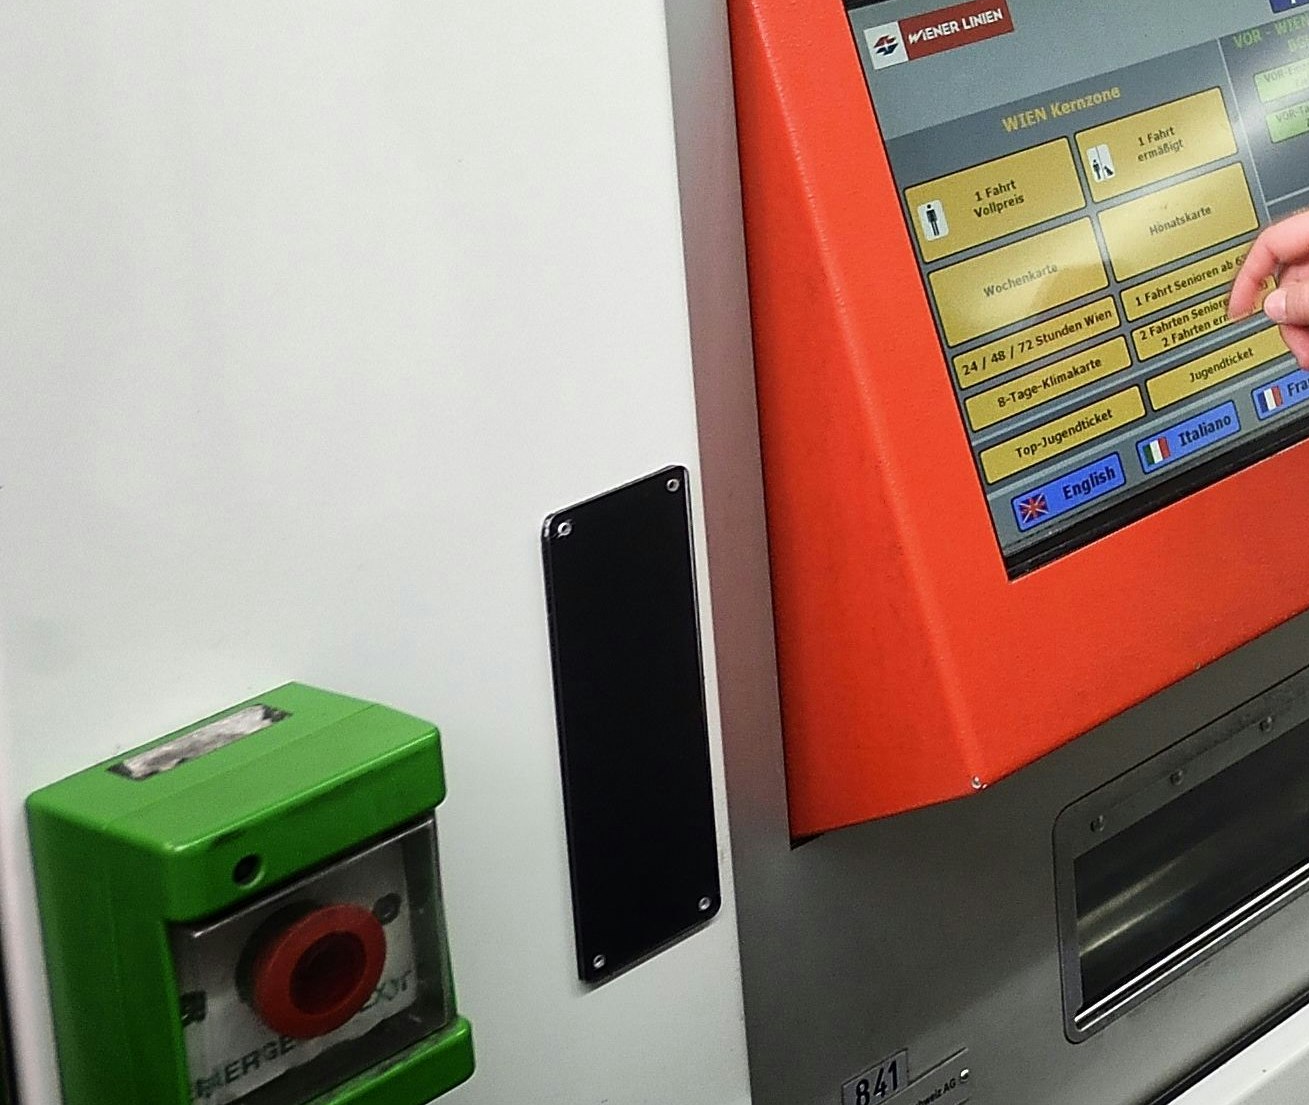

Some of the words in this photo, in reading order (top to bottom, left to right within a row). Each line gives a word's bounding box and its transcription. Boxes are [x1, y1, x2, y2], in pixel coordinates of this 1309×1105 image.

[908, 20, 961, 45] WIENER
[962, 8, 1003, 31] LINIEN
[1233, 28, 1262, 49] VOR
[1002, 109, 1047, 133] WIEN
[1050, 85, 1121, 119] Kernzone
[1137, 138, 1184, 163] ermäßigt
[1138, 136, 1144, 147] 1
[1147, 126, 1175, 144] Fahrt
[973, 193, 1025, 219] Vollpreis
[975, 191, 982, 202] 1
[985, 180, 1017, 199] Fahrt
[983, 263, 1058, 298] Wochenkarte
[1135, 296, 1142, 307] 1
[1145, 284, 1172, 304] Fahrt
[1173, 268, 1220, 292] Senioren
[1221, 259, 1234, 275] ab
[1140, 330, 1148, 341] 2
[1150, 315, 1189, 337] Fahrten
[1191, 297, 1230, 322] Seniore
[1162, 337, 1169, 348] 2
[1171, 321, 1210, 344] Fahrten
[962, 363, 978, 376] 24
[991, 350, 1006, 363] 48
[1018, 340, 1034, 353] 72
[1035, 321, 1083, 347] Stunden
[1084, 308, 1112, 329] Wien
[997, 357, 1102, 408] 8-Tage-Klimakarte
[1188, 347, 1254, 384] Jugendticket
[1015, 408, 1113, 459] Top-Jugendticket
[1179, 414, 1232, 447] Italiano
[1063, 466, 1116, 500] English
[855, 1060, 898, 1105] 841
[942, 1077, 957, 1095] AG
